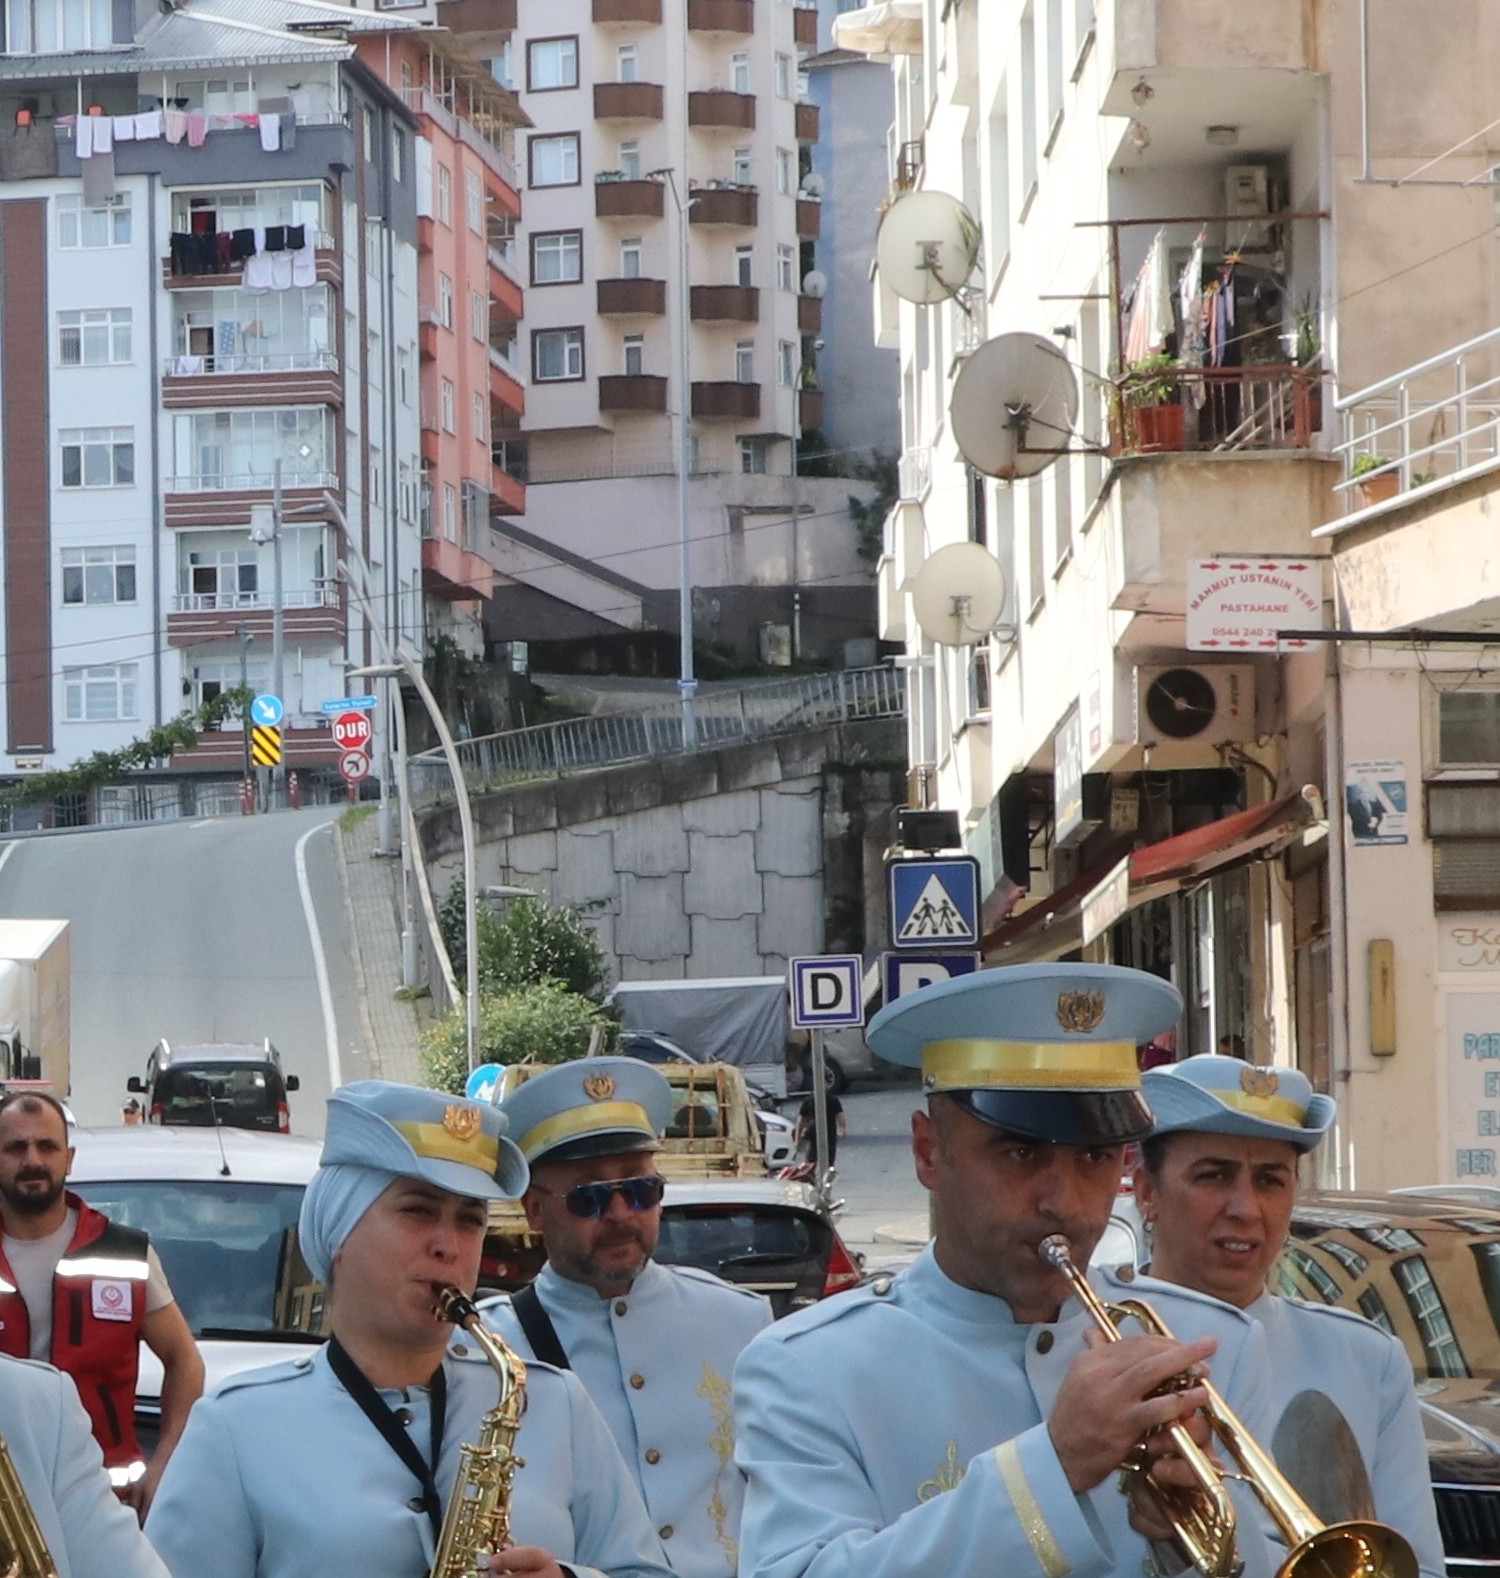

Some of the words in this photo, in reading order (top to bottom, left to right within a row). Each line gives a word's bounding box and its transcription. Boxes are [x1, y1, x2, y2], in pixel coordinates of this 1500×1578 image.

[1220, 604, 1289, 613] PASTAHANE
[335, 721, 368, 740] DUR
[811, 972, 843, 1010] D
[1456, 1148, 1497, 1178] HER
